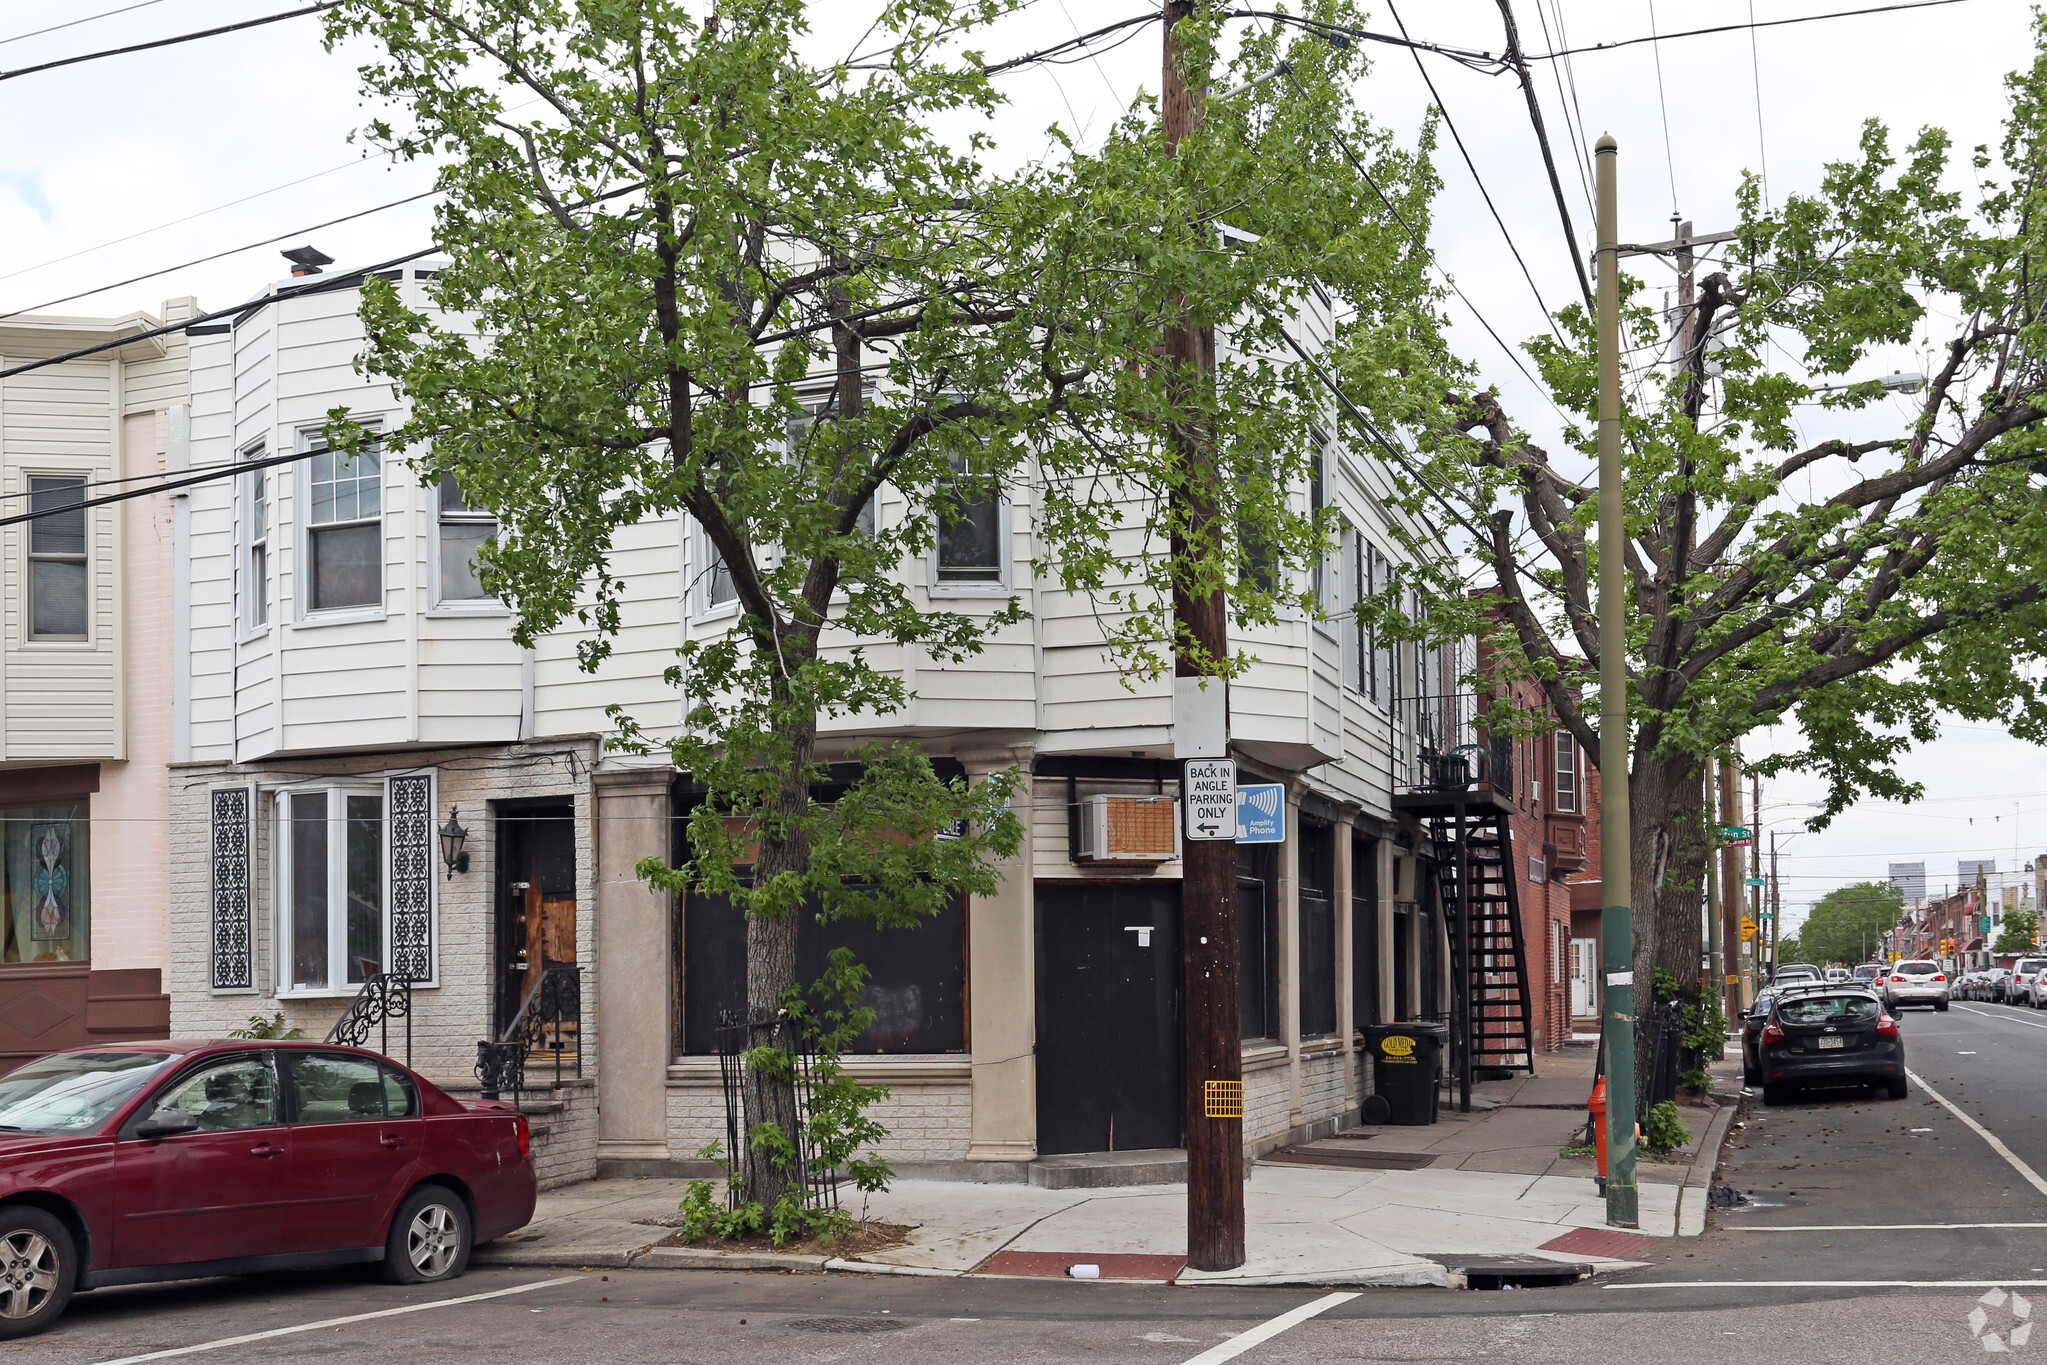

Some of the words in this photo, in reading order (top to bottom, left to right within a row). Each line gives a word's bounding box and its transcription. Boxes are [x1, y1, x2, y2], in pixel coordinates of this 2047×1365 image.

[1190, 767, 1217, 778] BACK
[1220, 767, 1230, 778] IN
[1194, 781, 1228, 791] ANGLE
[1190, 794, 1233, 805] PARKING
[1197, 807, 1226, 819] ONLY
[1249, 819, 1274, 827] Amplify
[1249, 826, 1276, 835] Phone
